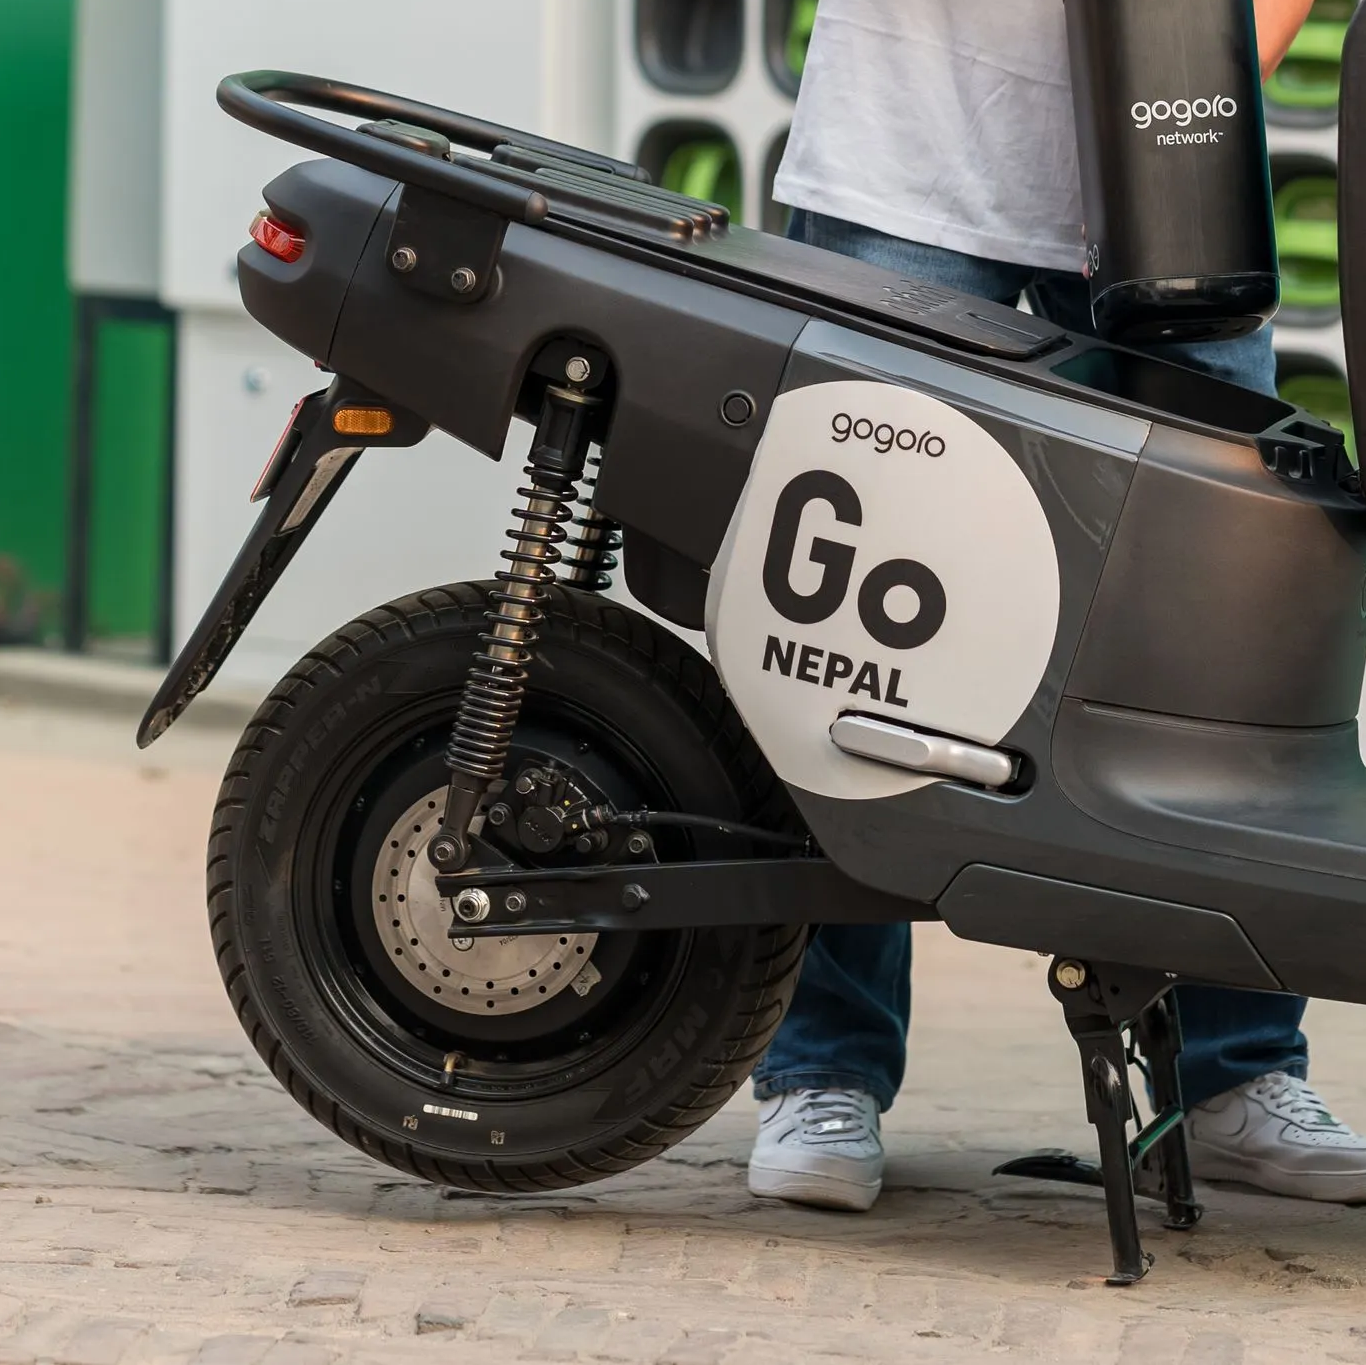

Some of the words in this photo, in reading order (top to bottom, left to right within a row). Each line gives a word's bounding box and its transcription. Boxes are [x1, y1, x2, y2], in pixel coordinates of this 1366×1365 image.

[1131, 95, 1237, 129] gogoro
[831, 413, 946, 458] gogoro
[763, 470, 947, 650] Go
[762, 635, 909, 708] NEPAL
